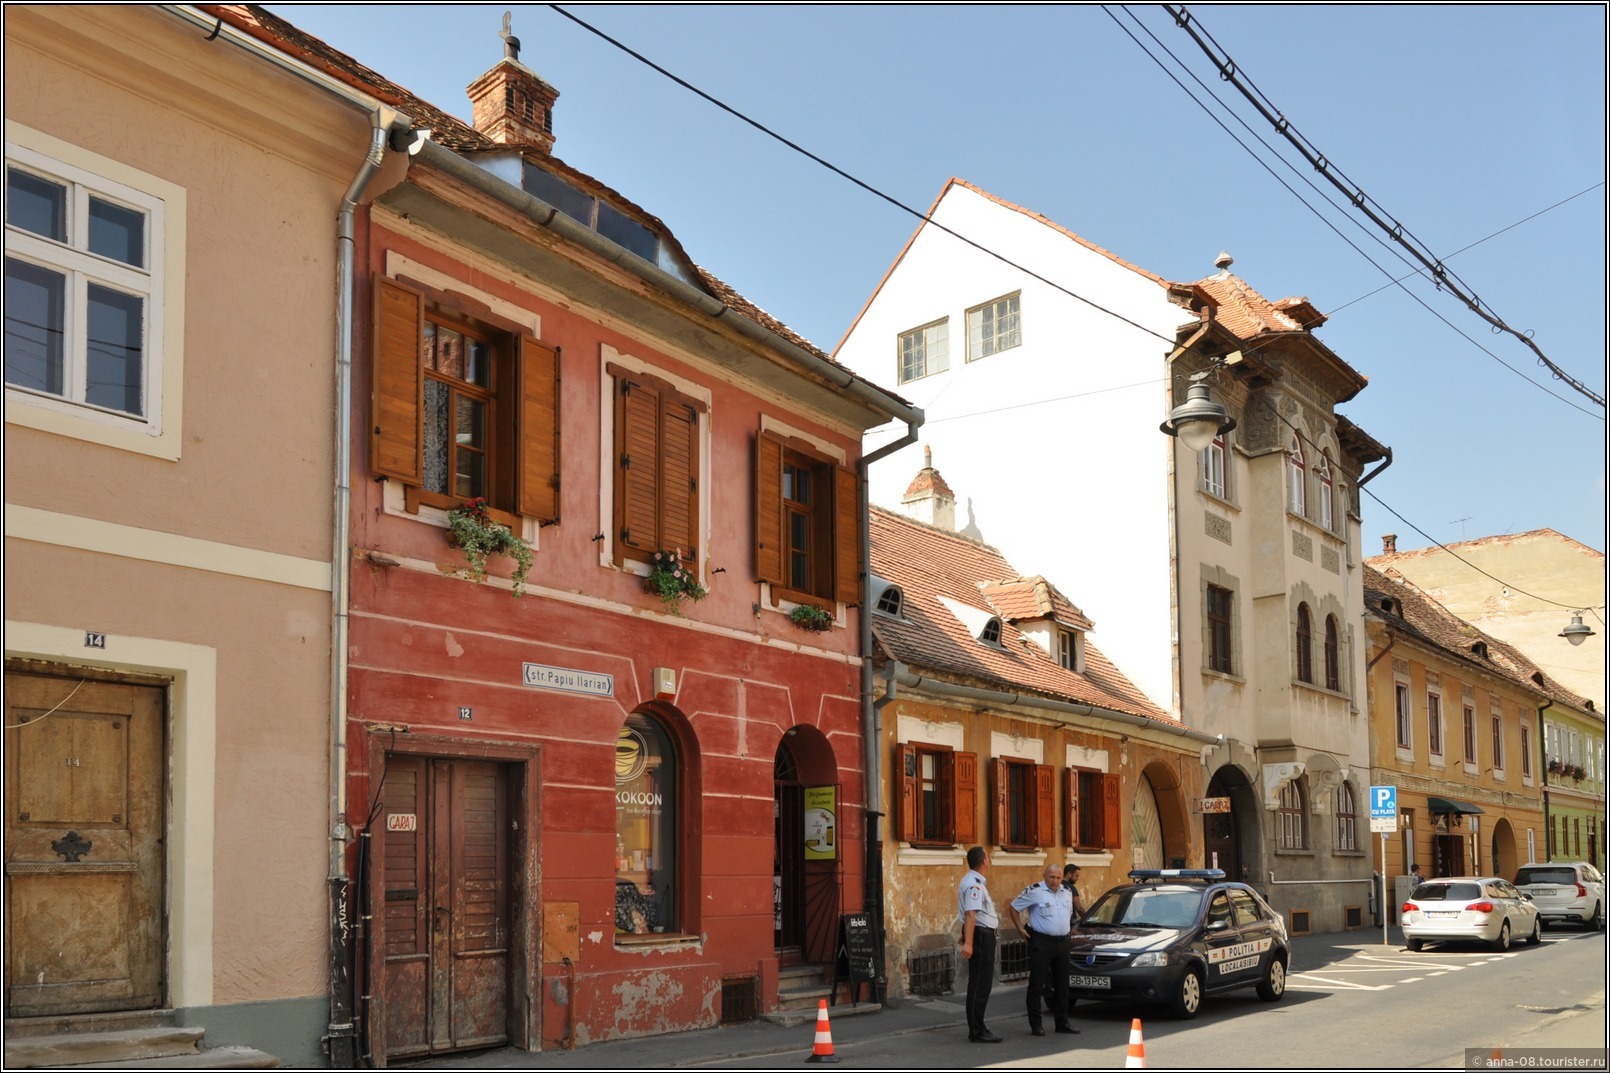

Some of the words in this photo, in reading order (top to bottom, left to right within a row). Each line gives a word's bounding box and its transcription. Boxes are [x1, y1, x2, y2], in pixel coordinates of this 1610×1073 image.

[88, 634, 103, 647] 14
[531, 670, 547, 682] str.
[548, 671, 574, 687] Papiu
[577, 675, 607, 690] Ilarian
[460, 708, 470, 718] 12
[66, 758, 80, 767] 14
[616, 791, 662, 806] KOKOON
[1377, 789, 1391, 808] P
